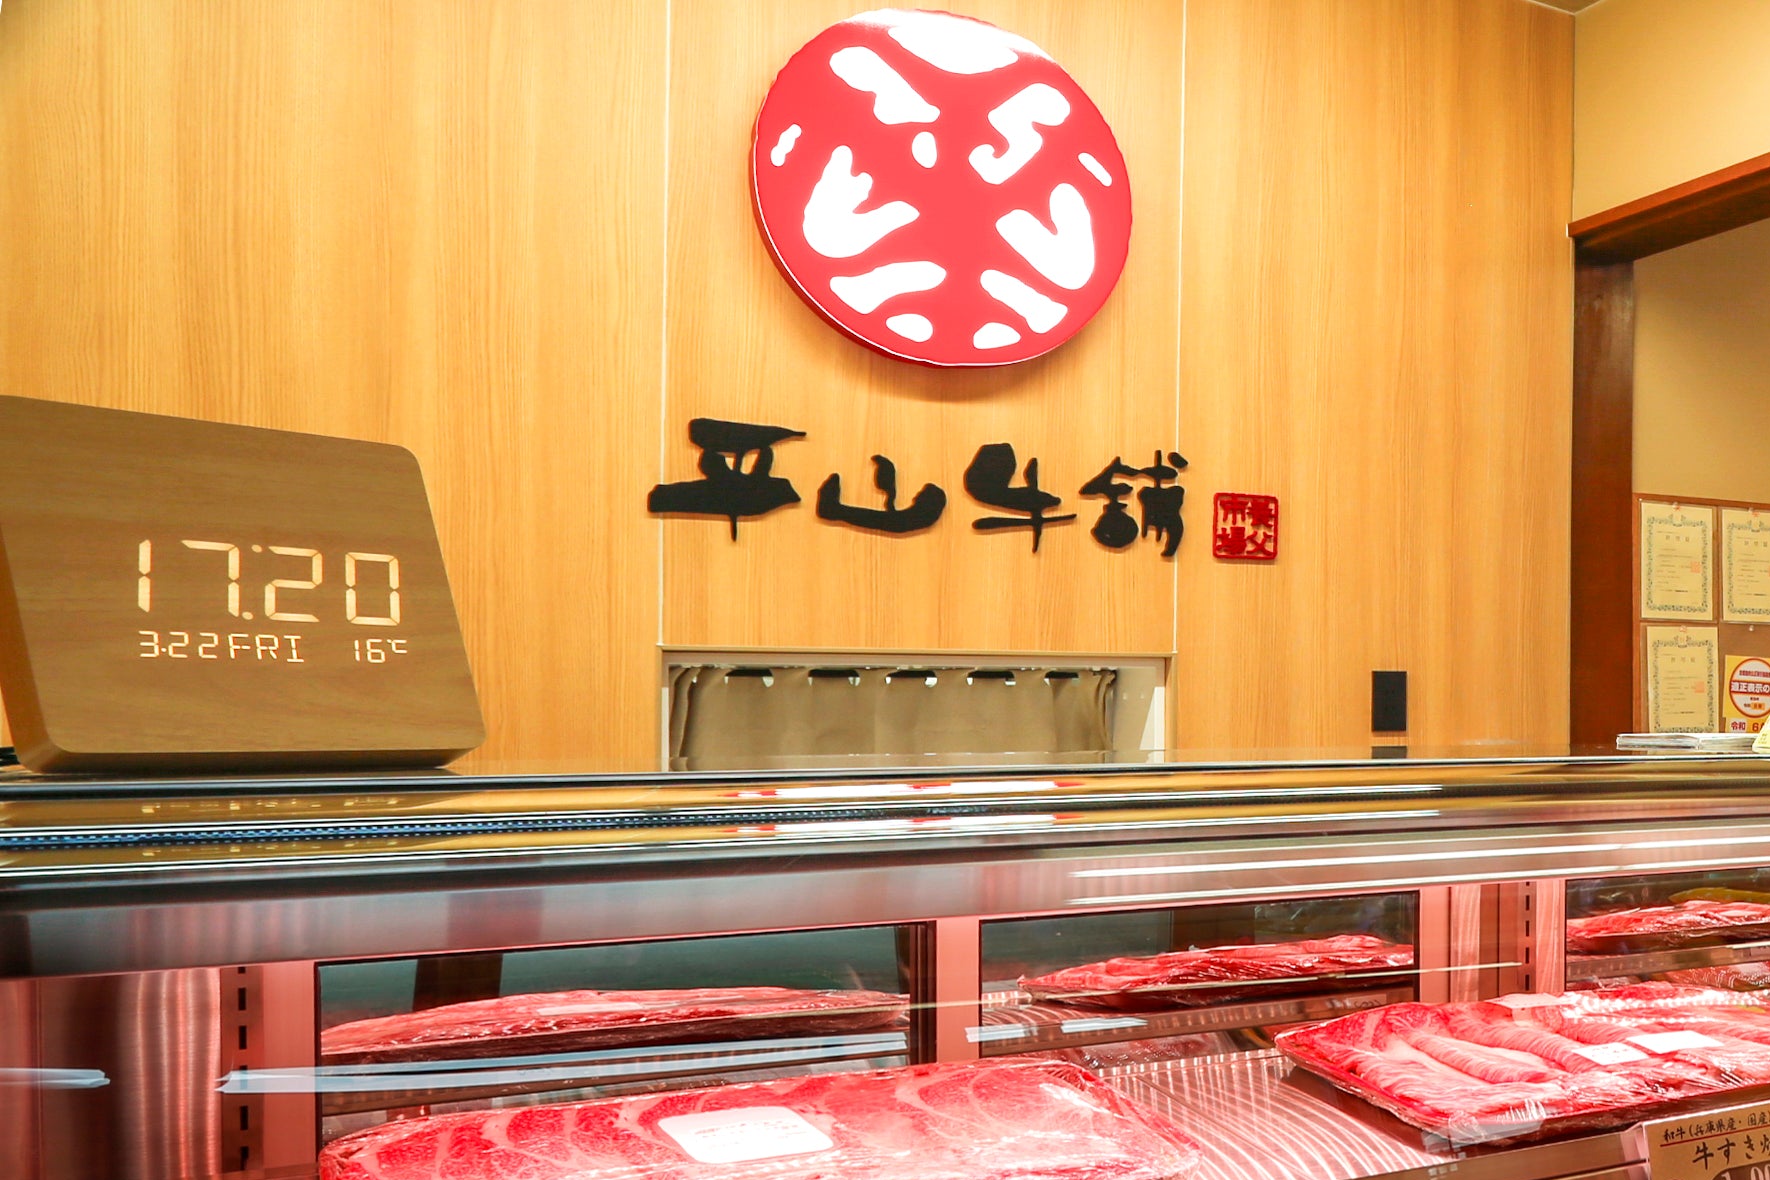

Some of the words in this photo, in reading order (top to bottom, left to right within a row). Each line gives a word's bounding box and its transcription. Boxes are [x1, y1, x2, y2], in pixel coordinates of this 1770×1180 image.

[647, 417, 1189, 557] 平山牛舗
[138, 539, 400, 626] 17:20
